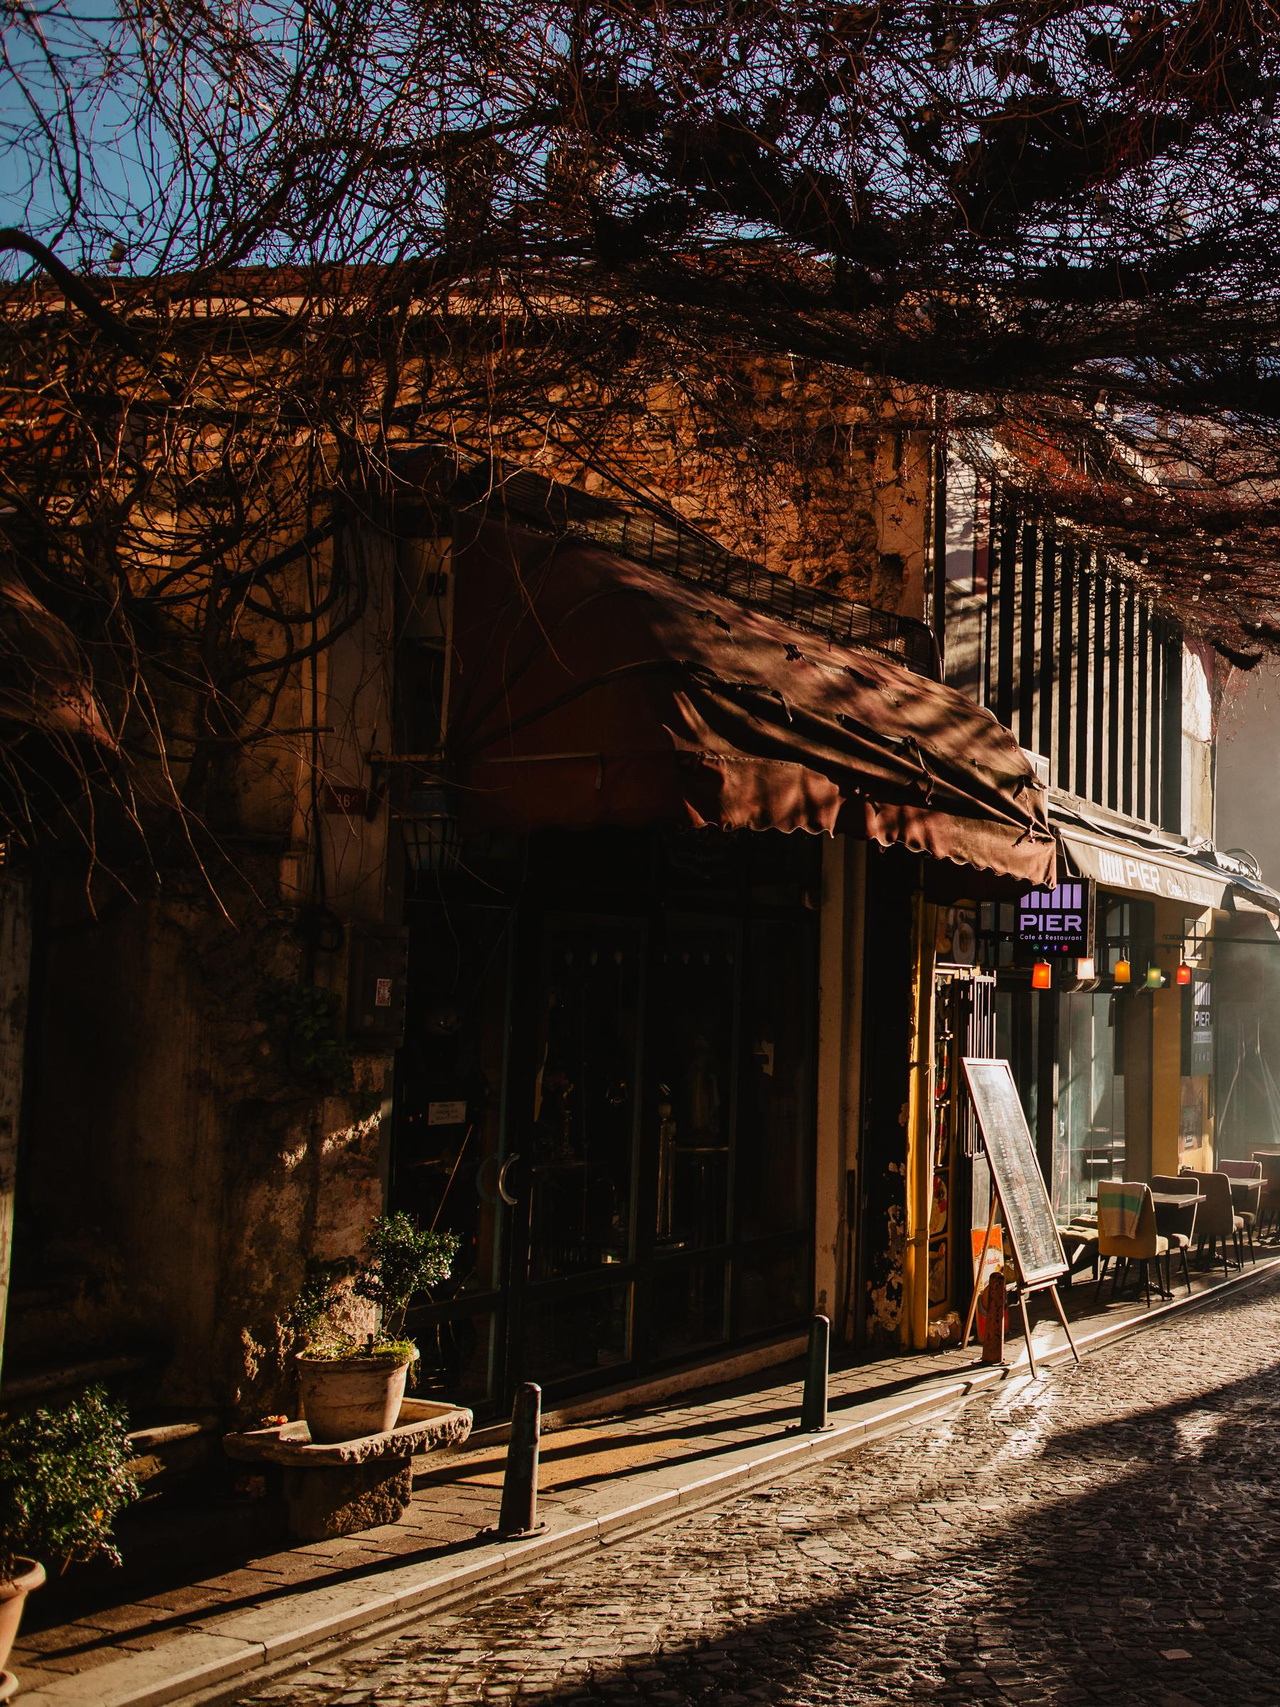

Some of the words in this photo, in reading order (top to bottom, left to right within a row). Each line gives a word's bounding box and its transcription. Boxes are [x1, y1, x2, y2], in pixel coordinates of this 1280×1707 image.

[1126, 860, 1161, 892] PIER
[1020, 914, 1083, 932] PIER
[1045, 934, 1083, 942] Restaurant
[1194, 1010, 1211, 1027] PIER
